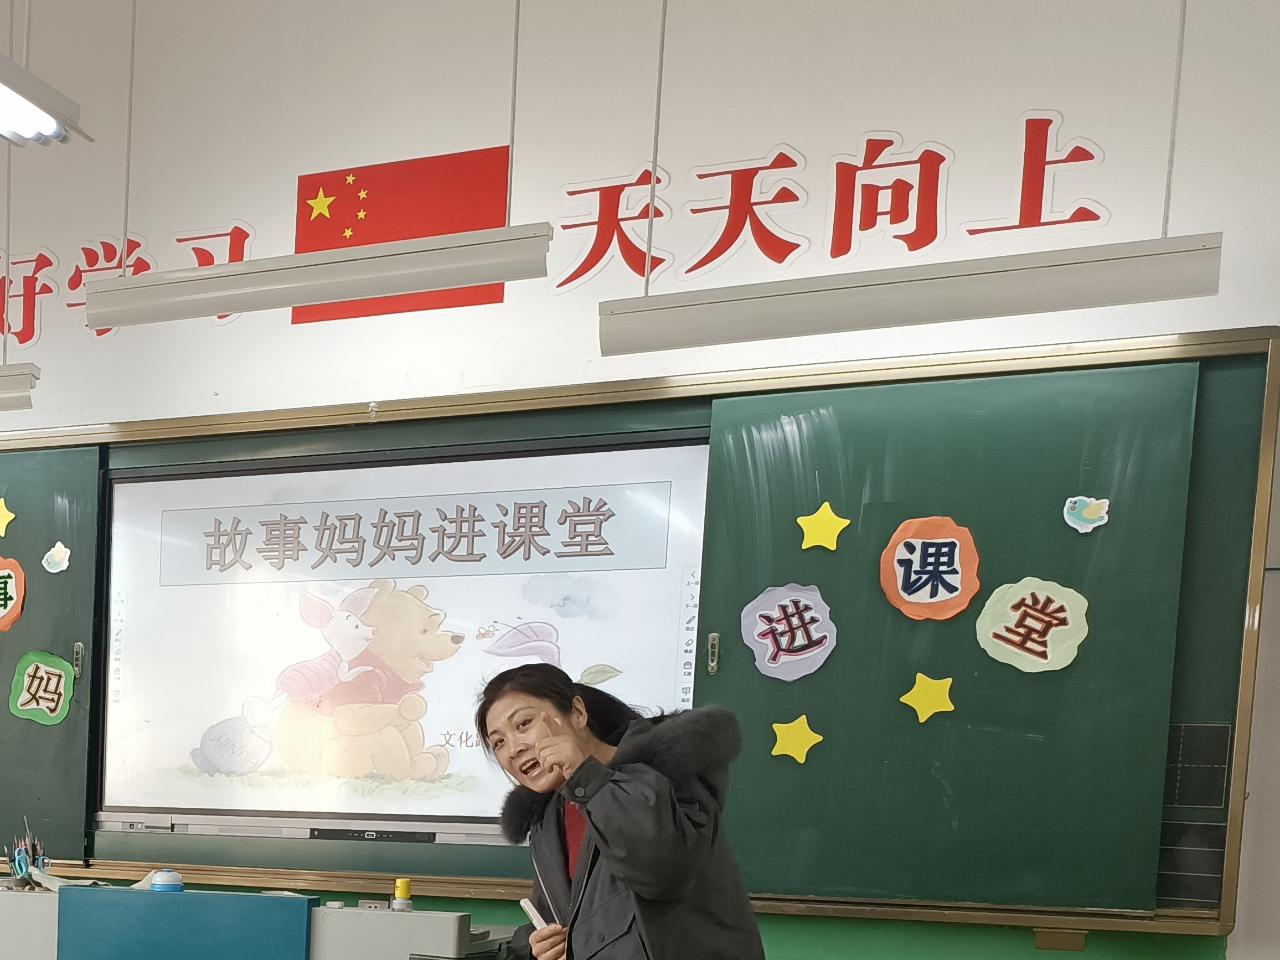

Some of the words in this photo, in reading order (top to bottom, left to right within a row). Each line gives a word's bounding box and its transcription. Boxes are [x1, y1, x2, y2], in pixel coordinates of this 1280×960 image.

[556, 118, 1101, 289] 天天向上
[203, 496, 616, 573] 故事妈妈进课堂
[440, 730, 482, 748] 文化
